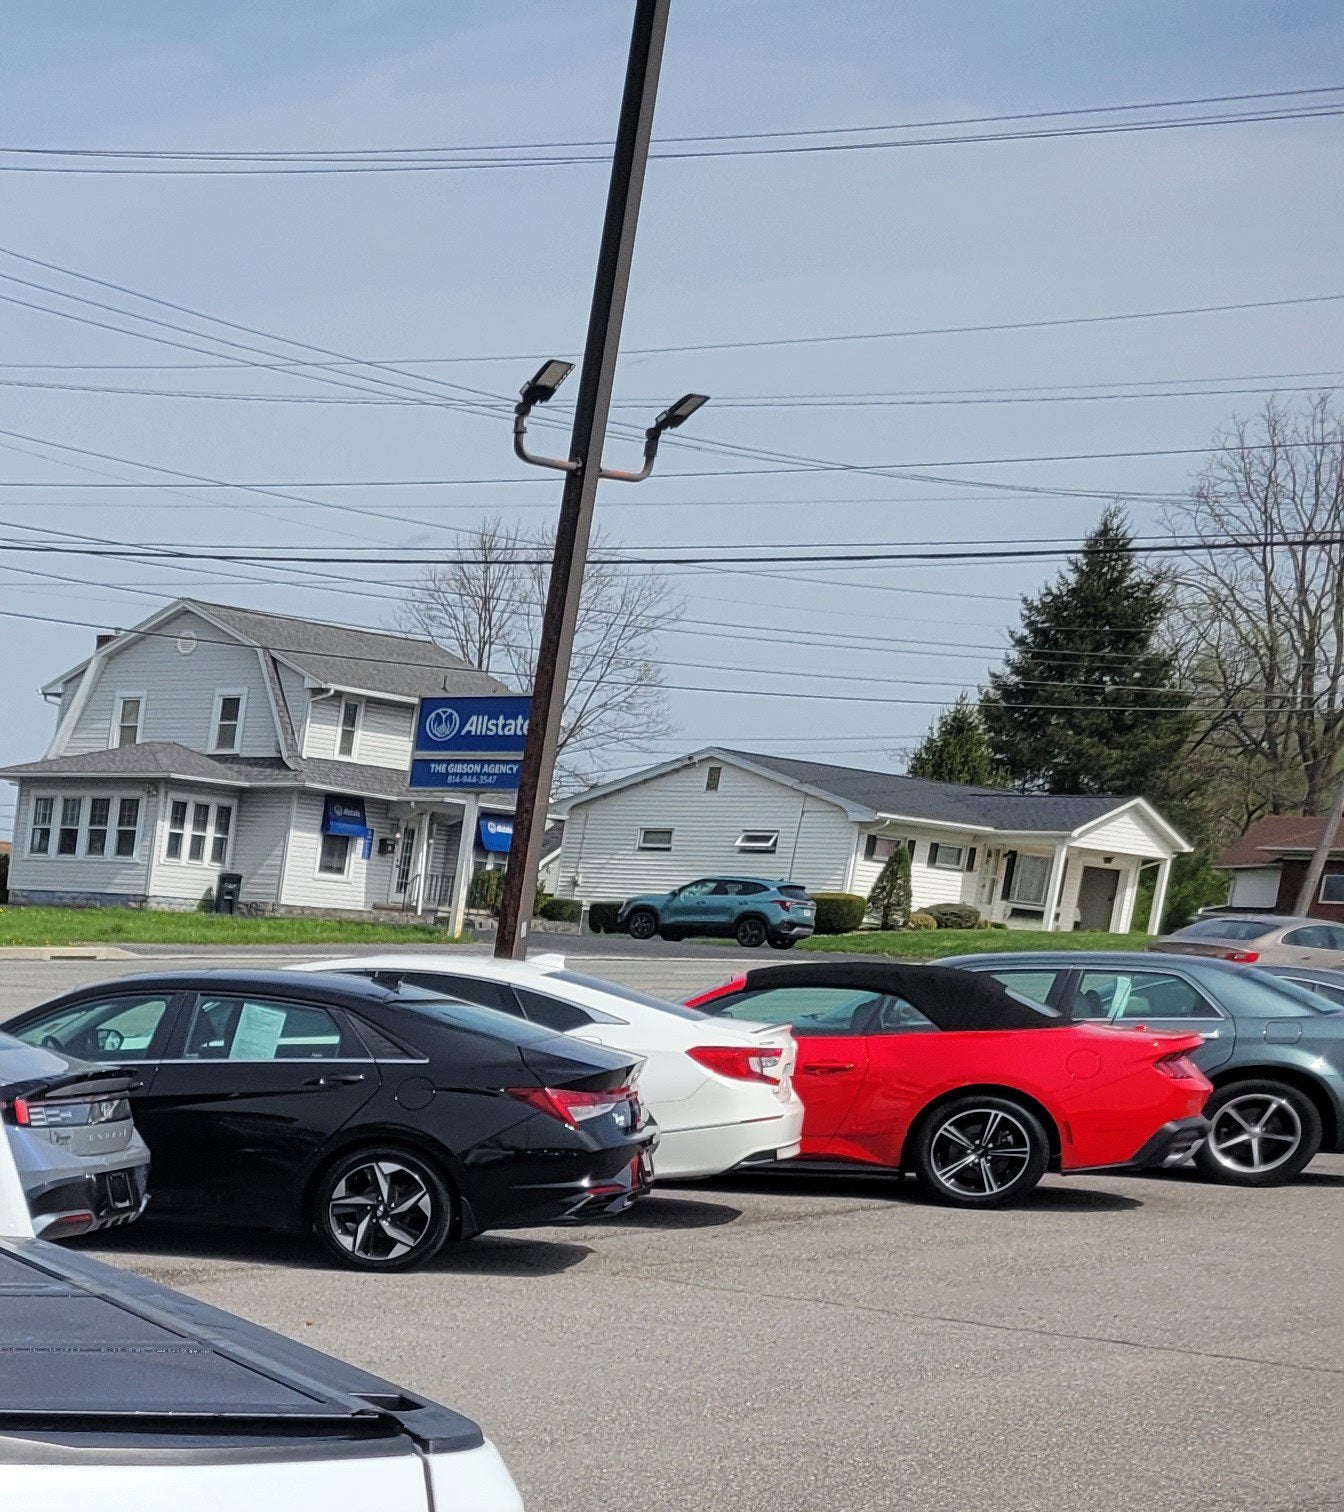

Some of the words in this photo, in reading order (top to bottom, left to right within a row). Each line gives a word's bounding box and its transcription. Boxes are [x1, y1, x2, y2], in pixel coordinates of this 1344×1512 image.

[430, 763, 447, 773] THE
[447, 763, 481, 773] GIBSON
[481, 764, 519, 774] AGENCY
[447, 774, 497, 784] 814-944-3547
